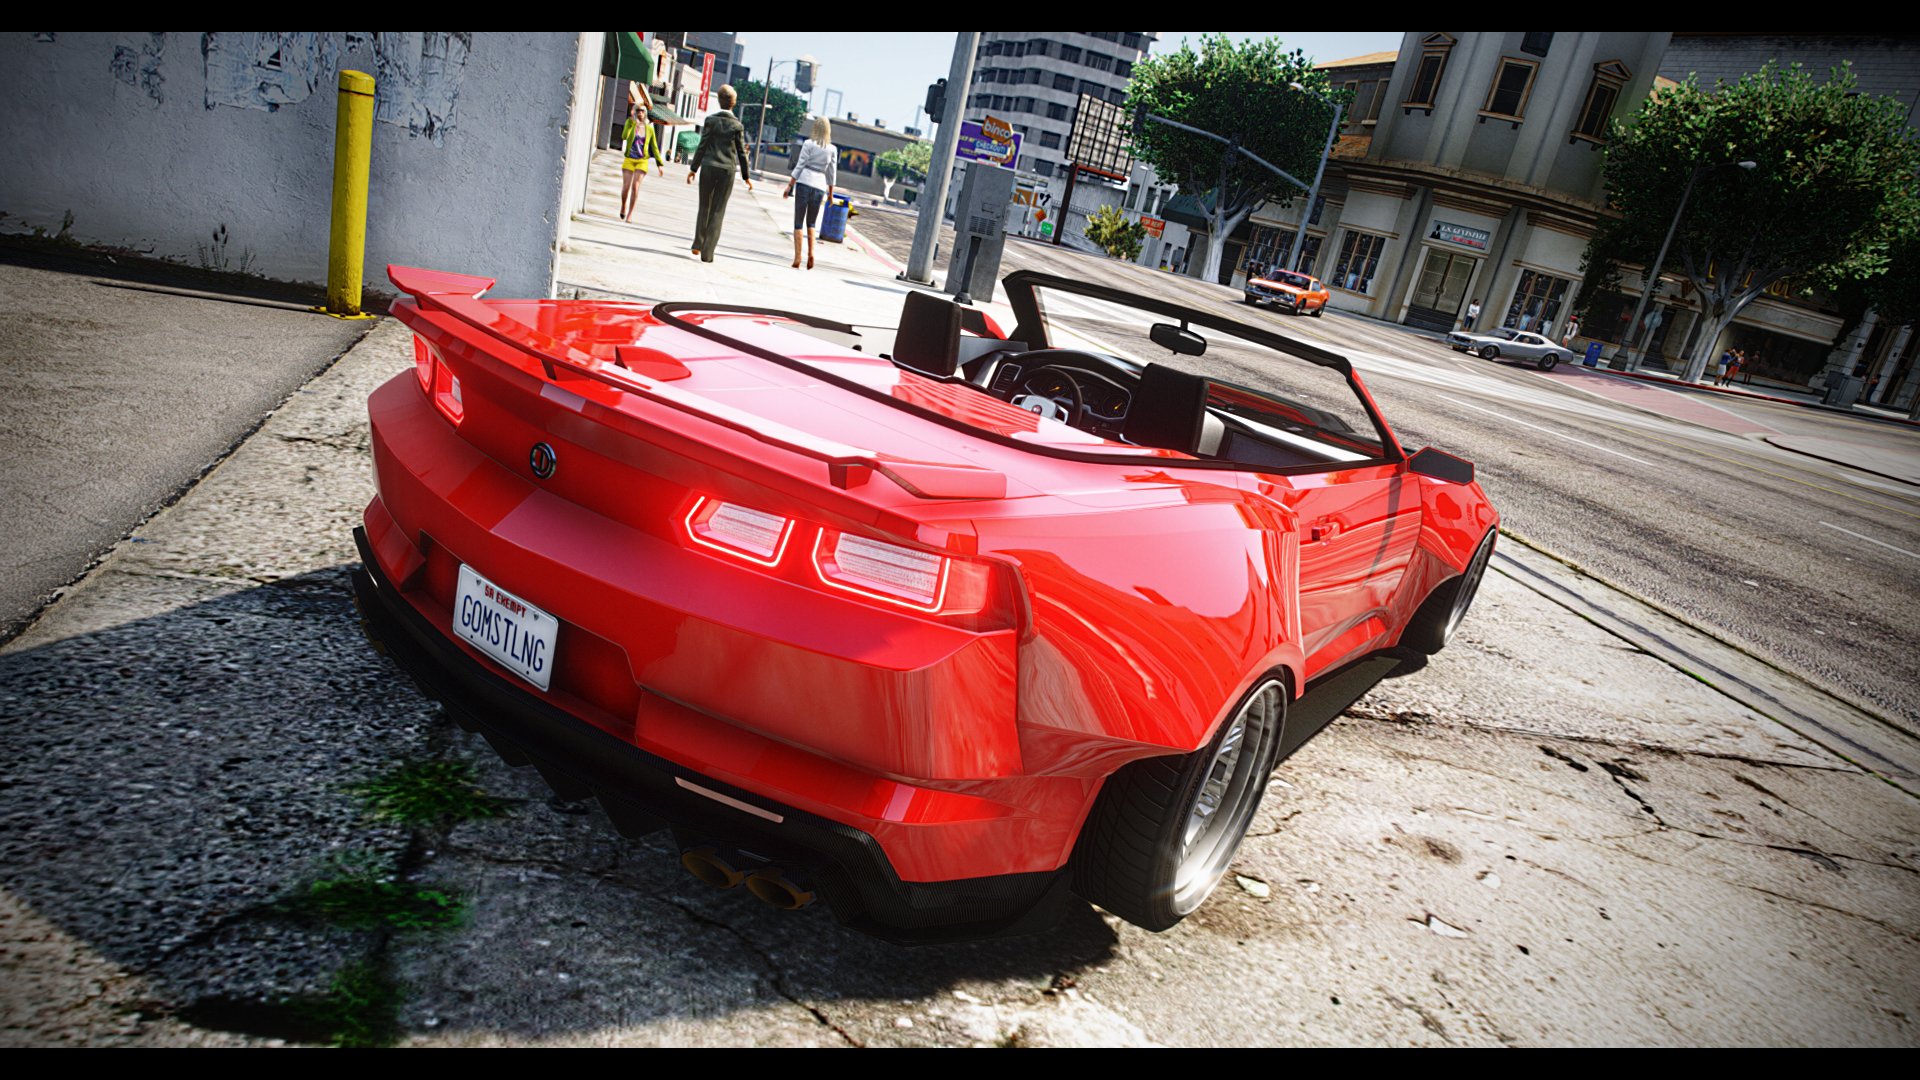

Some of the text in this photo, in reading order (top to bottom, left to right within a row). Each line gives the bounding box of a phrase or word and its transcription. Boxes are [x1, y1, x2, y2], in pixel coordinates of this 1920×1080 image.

[984, 120, 1010, 139] binco
[496, 591, 527, 618] EXEMPT
[462, 594, 545, 672] GOMSTLNG
